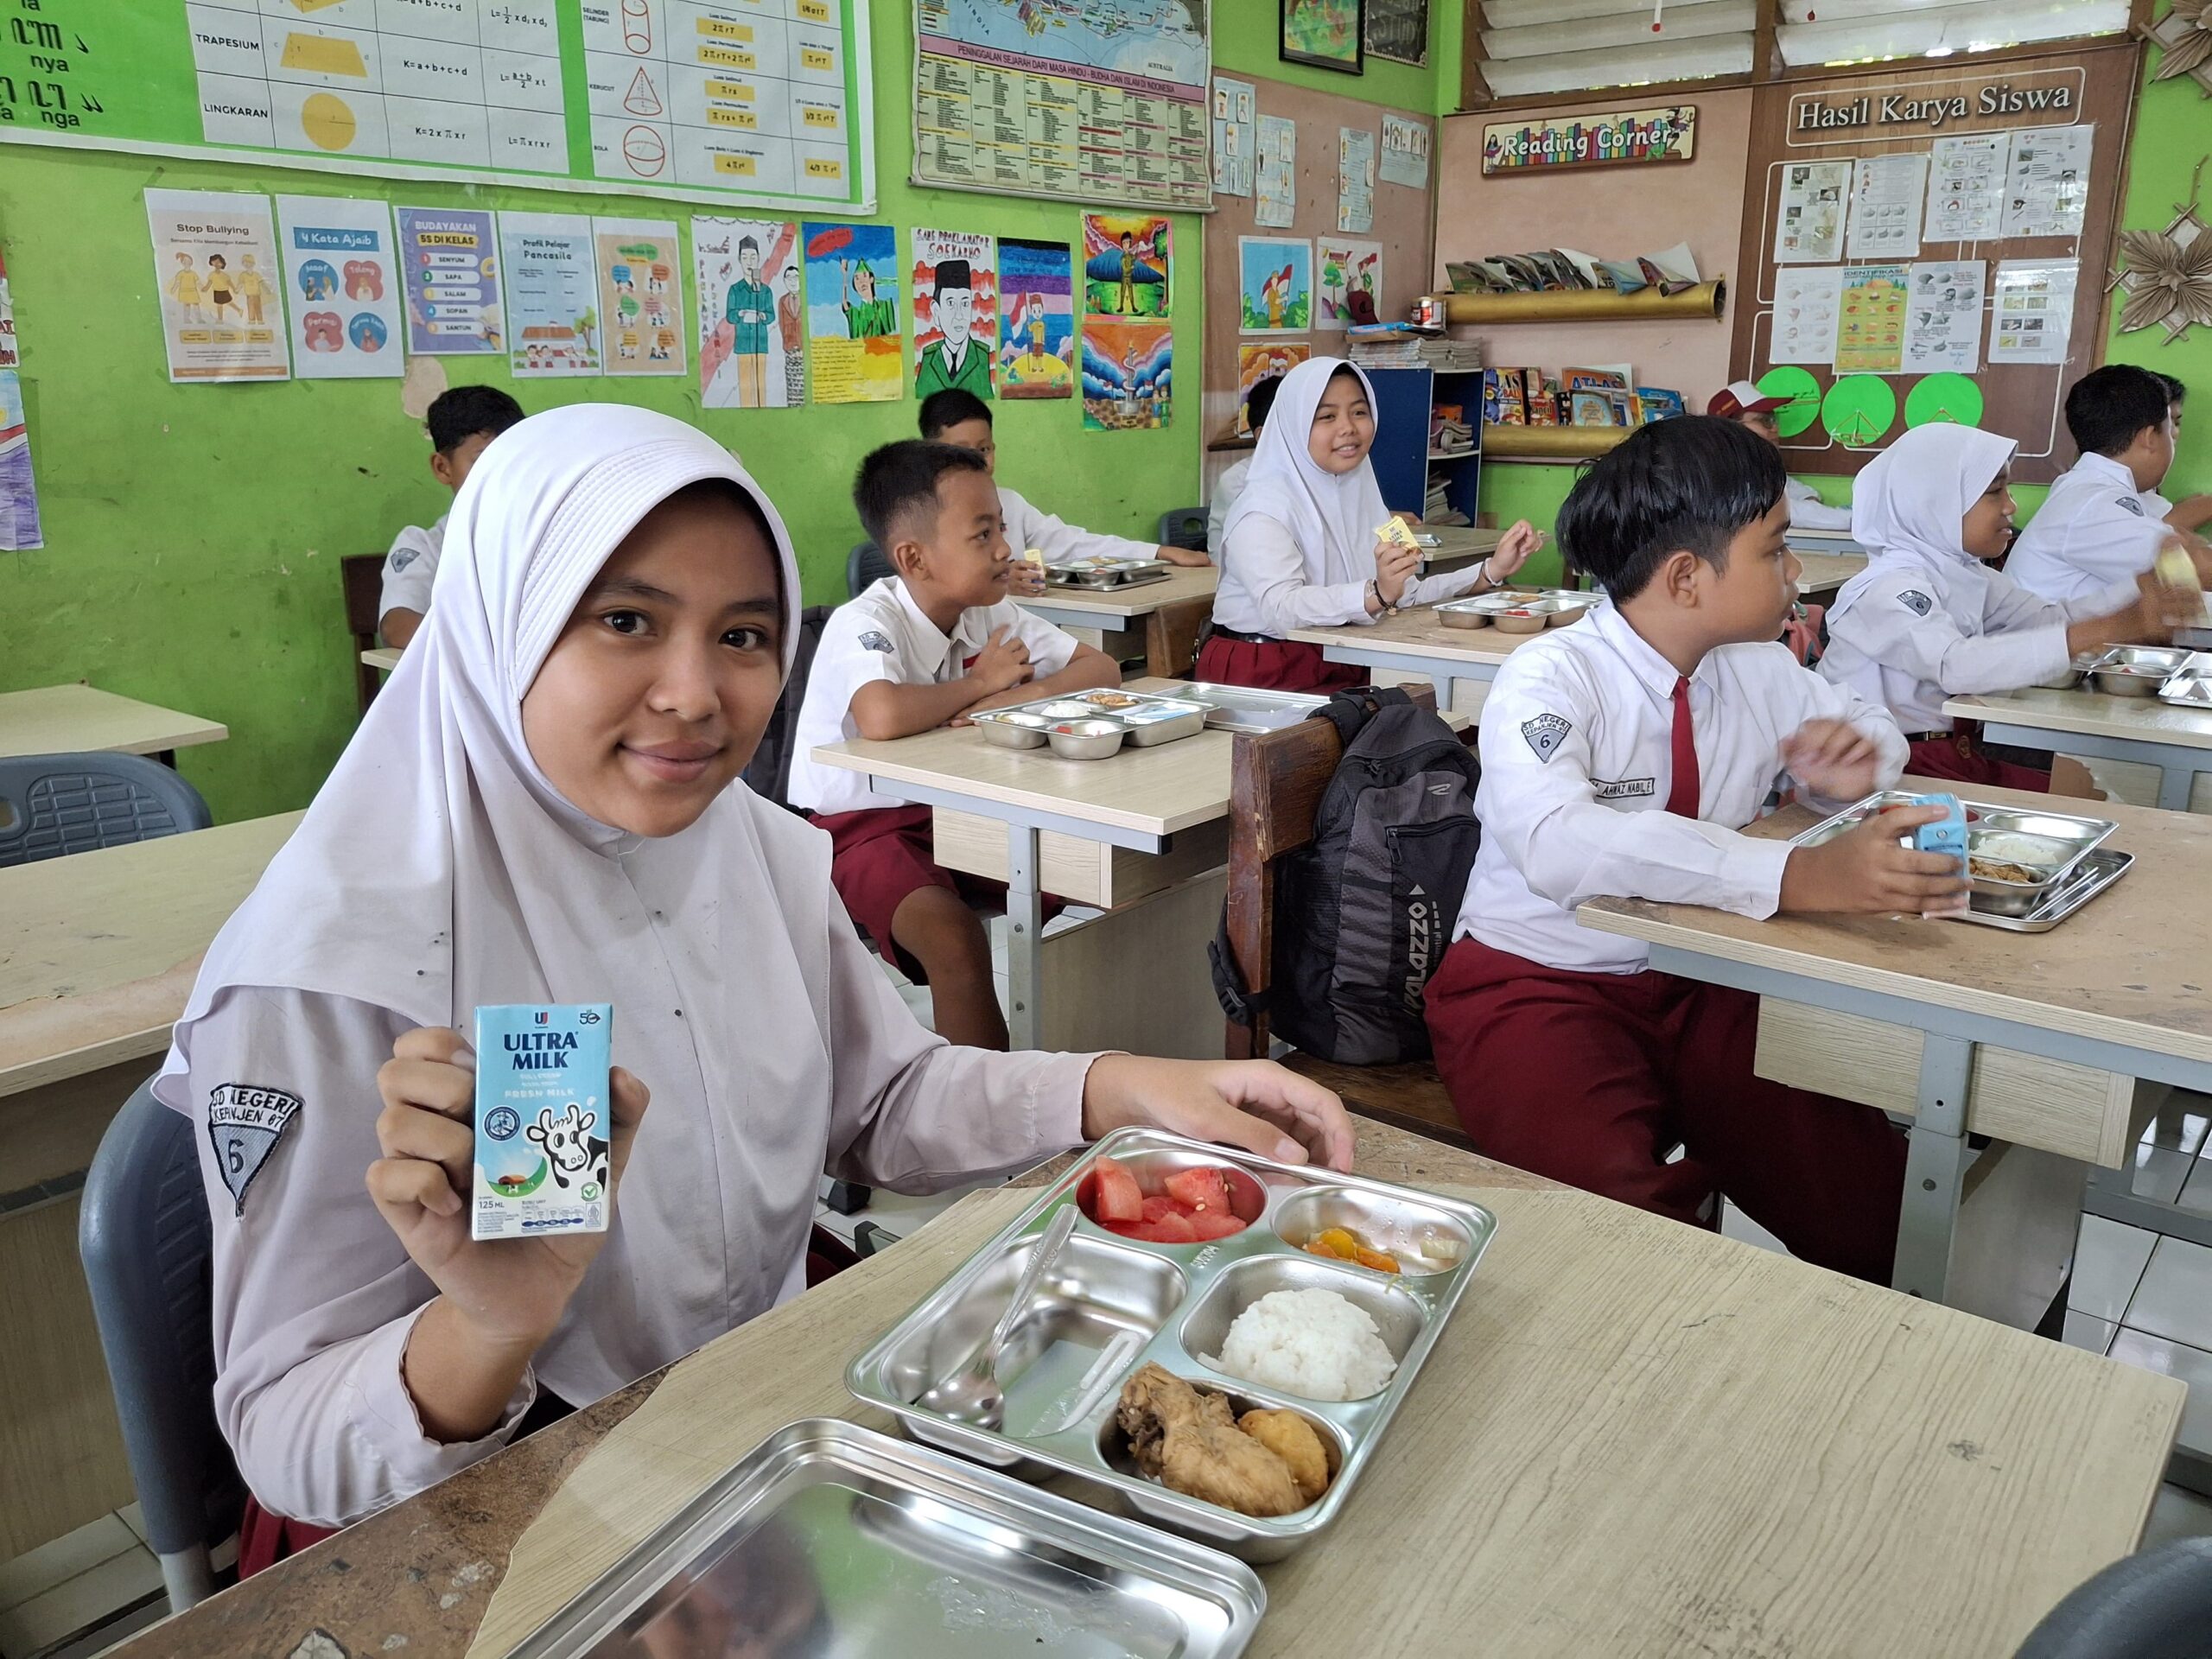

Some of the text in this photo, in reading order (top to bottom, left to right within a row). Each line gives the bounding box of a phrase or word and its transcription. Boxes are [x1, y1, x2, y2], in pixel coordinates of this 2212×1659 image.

[195, 34, 259, 50] TRAPESIUM
[30, 54, 69, 73] nya
[957, 45, 1002, 61] PENINGGALAN
[1003, 54, 1031, 68] SEJARAH
[1032, 60, 1048, 70] DARI
[1049, 63, 1067, 73] MASA
[1068, 67, 1087, 77] HINDU
[1090, 70, 1110, 81] BUDHA
[1111, 73, 1123, 83] DAN
[1124, 75, 1140, 86] ISLAM
[1147, 79, 1175, 92] INDONESIA
[204, 104, 268, 118] LINGKARAN
[1796, 84, 2071, 129] Hasil Karya Siswa
[41, 111, 80, 129] nga
[1504, 127, 1670, 157] Reading Corner
[177, 224, 249, 235] Stop Bullying
[415, 220, 476, 232] BUDAYAKAN
[302, 233, 372, 247] 4 Kata Ajaib
[421, 235, 474, 245] 5S DI KELAS
[545, 240, 570, 250] Pelajar
[524, 251, 572, 260] Pancasila
[927, 243, 982, 259] SOEKARNO
[1523, 715, 1568, 731] SD NEGERI
[1540, 734, 1551, 748] 6
[504, 1032, 578, 1051] ULTRA
[512, 1052, 569, 1070] MILK
[228, 1139, 245, 1174] 6
[479, 1200, 493, 1209] 125
